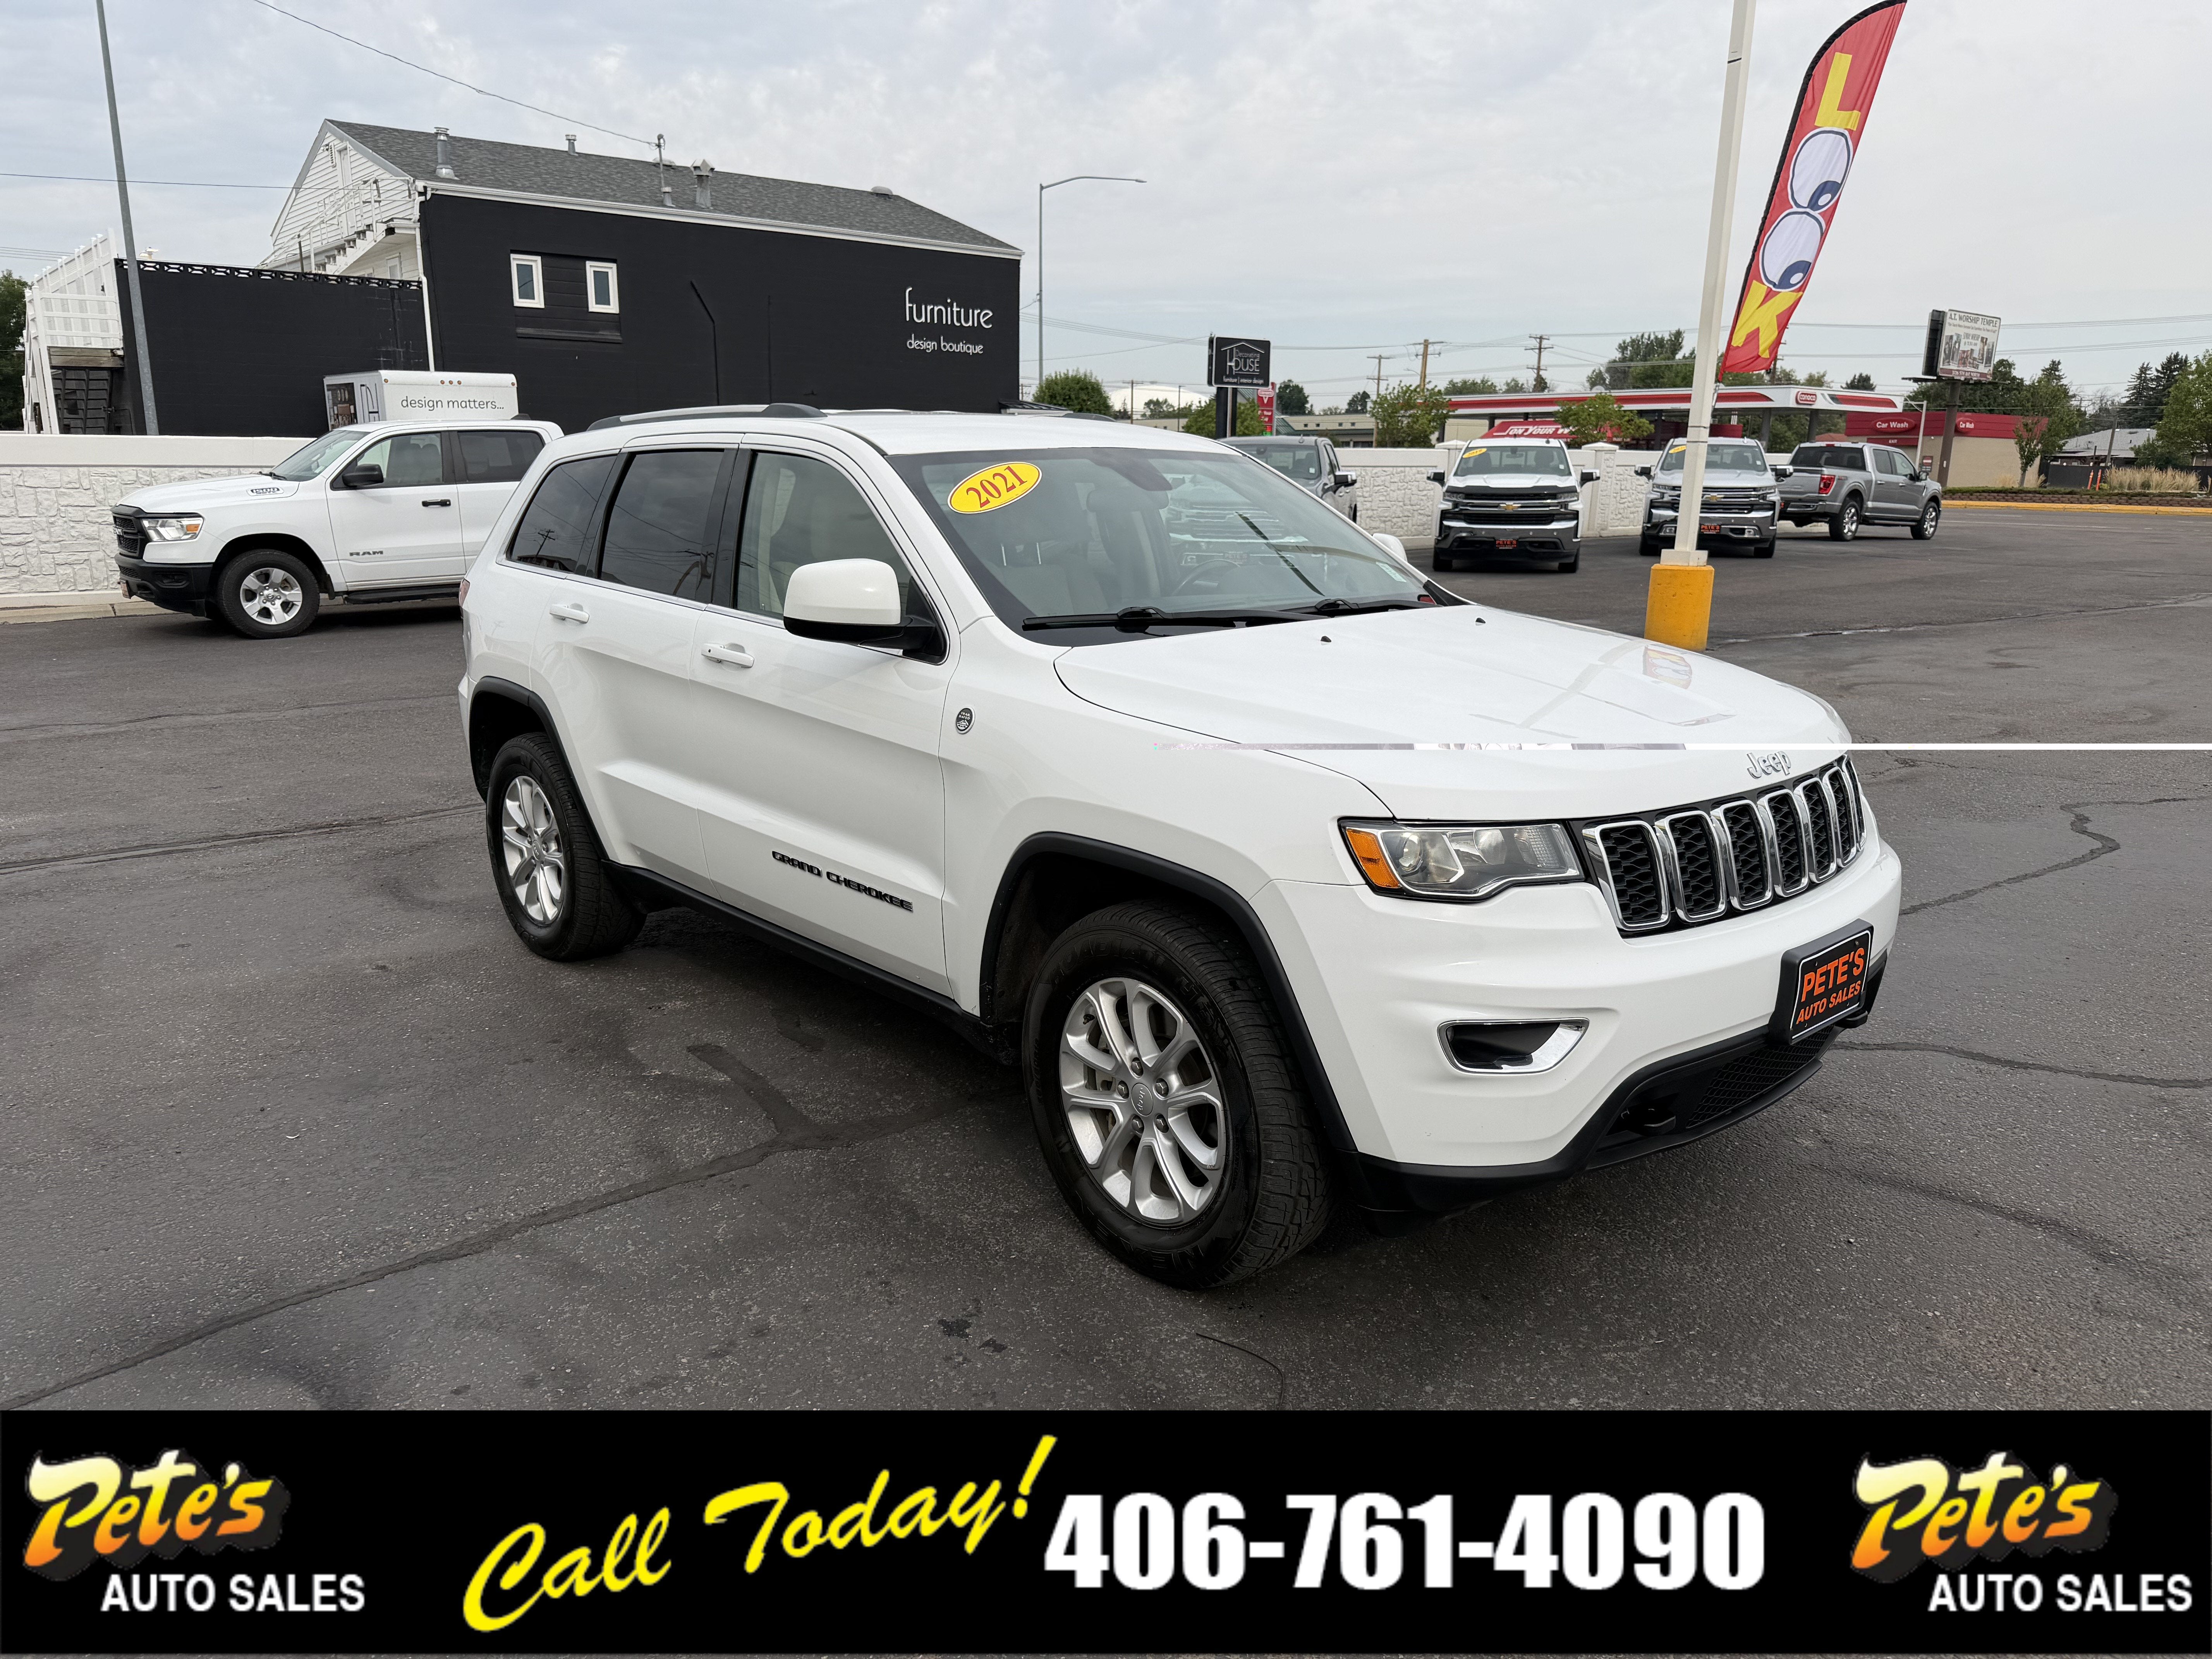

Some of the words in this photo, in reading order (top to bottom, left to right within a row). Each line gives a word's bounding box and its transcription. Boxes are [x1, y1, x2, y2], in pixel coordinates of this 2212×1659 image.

[905, 287, 993, 329] furniture
[1959, 314, 1980, 324] WORSHIP
[1981, 318, 1998, 328] TEMPLE
[907, 333, 937, 353] design
[940, 335, 984, 355] boutique
[1226, 347, 1260, 375] HOUSE
[401, 396, 443, 411] design
[447, 397, 504, 410] matters...
[966, 466, 1027, 508] 2021
[1746, 751, 1791, 779] Jeep
[772, 850, 823, 878] GRAND
[826, 871, 914, 913] CHEROKEE
[1801, 948, 1865, 1002] PETE'S
[1796, 998, 1827, 1025] AUTO
[1829, 980, 1861, 1008] SALES
